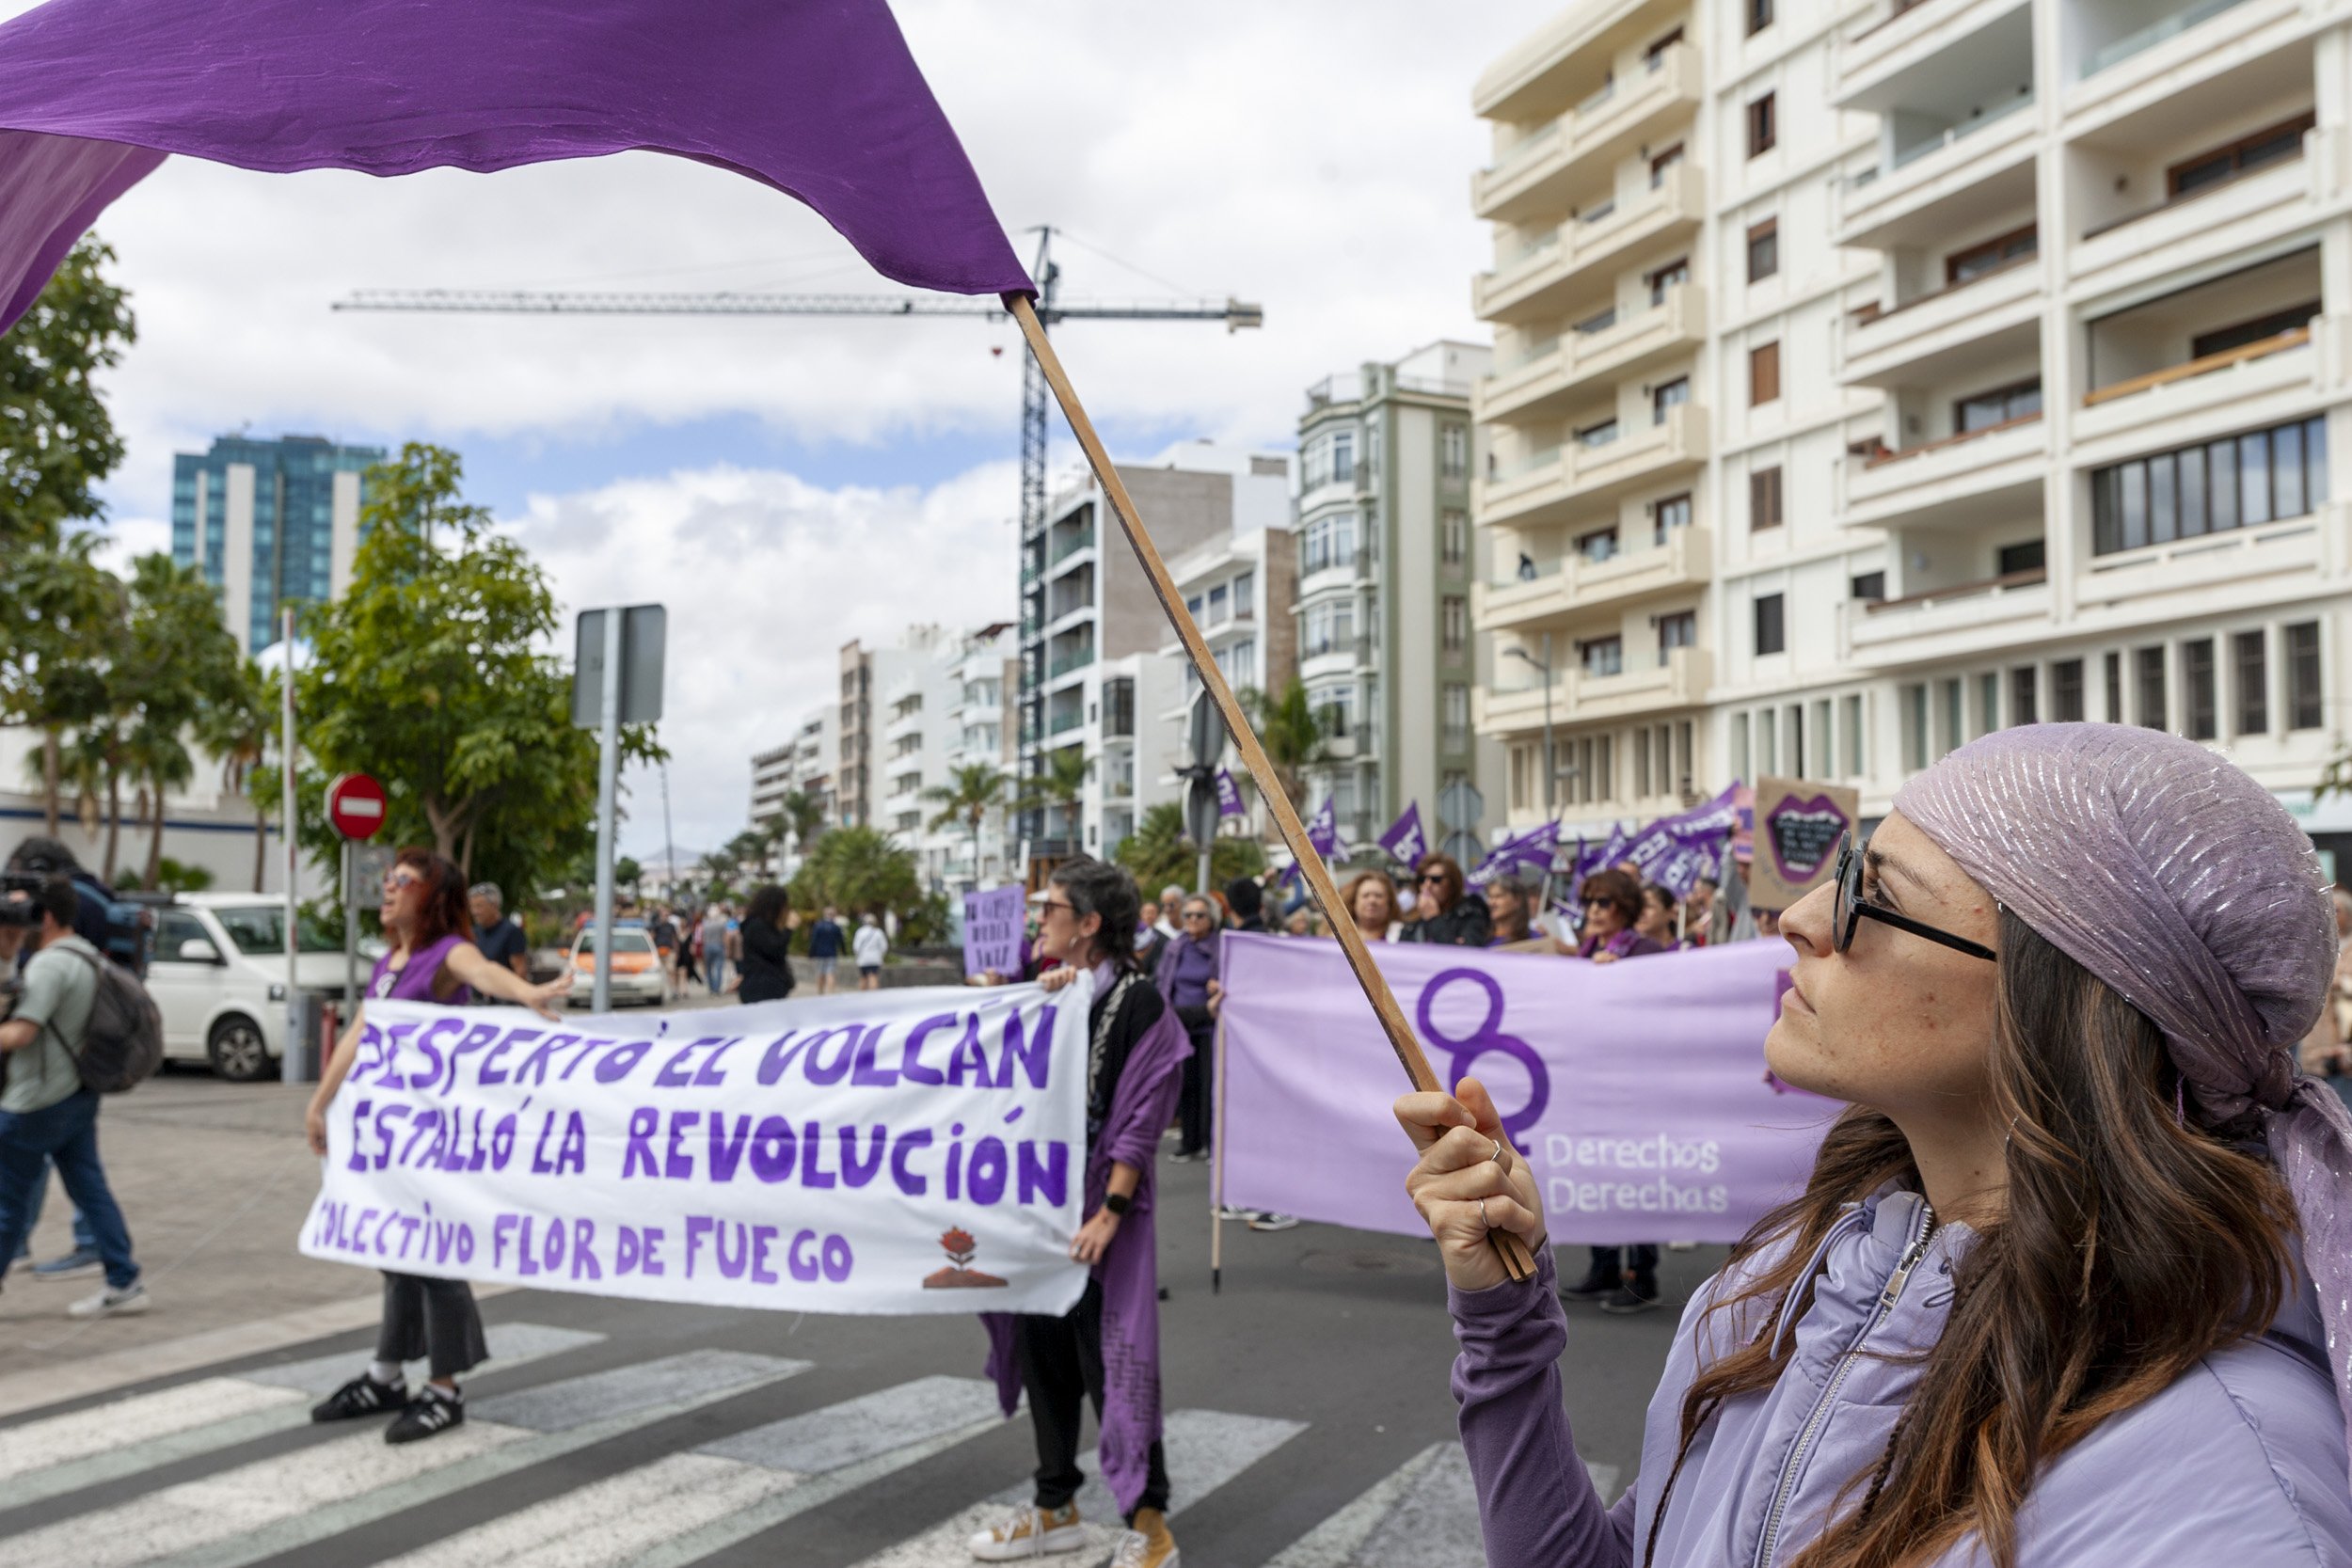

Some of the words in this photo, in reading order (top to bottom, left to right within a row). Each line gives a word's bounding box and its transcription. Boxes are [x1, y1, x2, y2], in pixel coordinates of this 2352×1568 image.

[652, 1037, 745, 1087] EL
[755, 998, 1058, 1089] VOLCÁN
[347, 1096, 532, 1173] ESTALLÓ
[530, 1110, 586, 1176] LA
[1545, 1132, 1722, 1174] Derechos
[1547, 1176, 1729, 1215] Derechas
[493, 1214, 603, 1280] FLOR
[615, 1225, 665, 1276] DE
[685, 1214, 854, 1285] FUEGO
